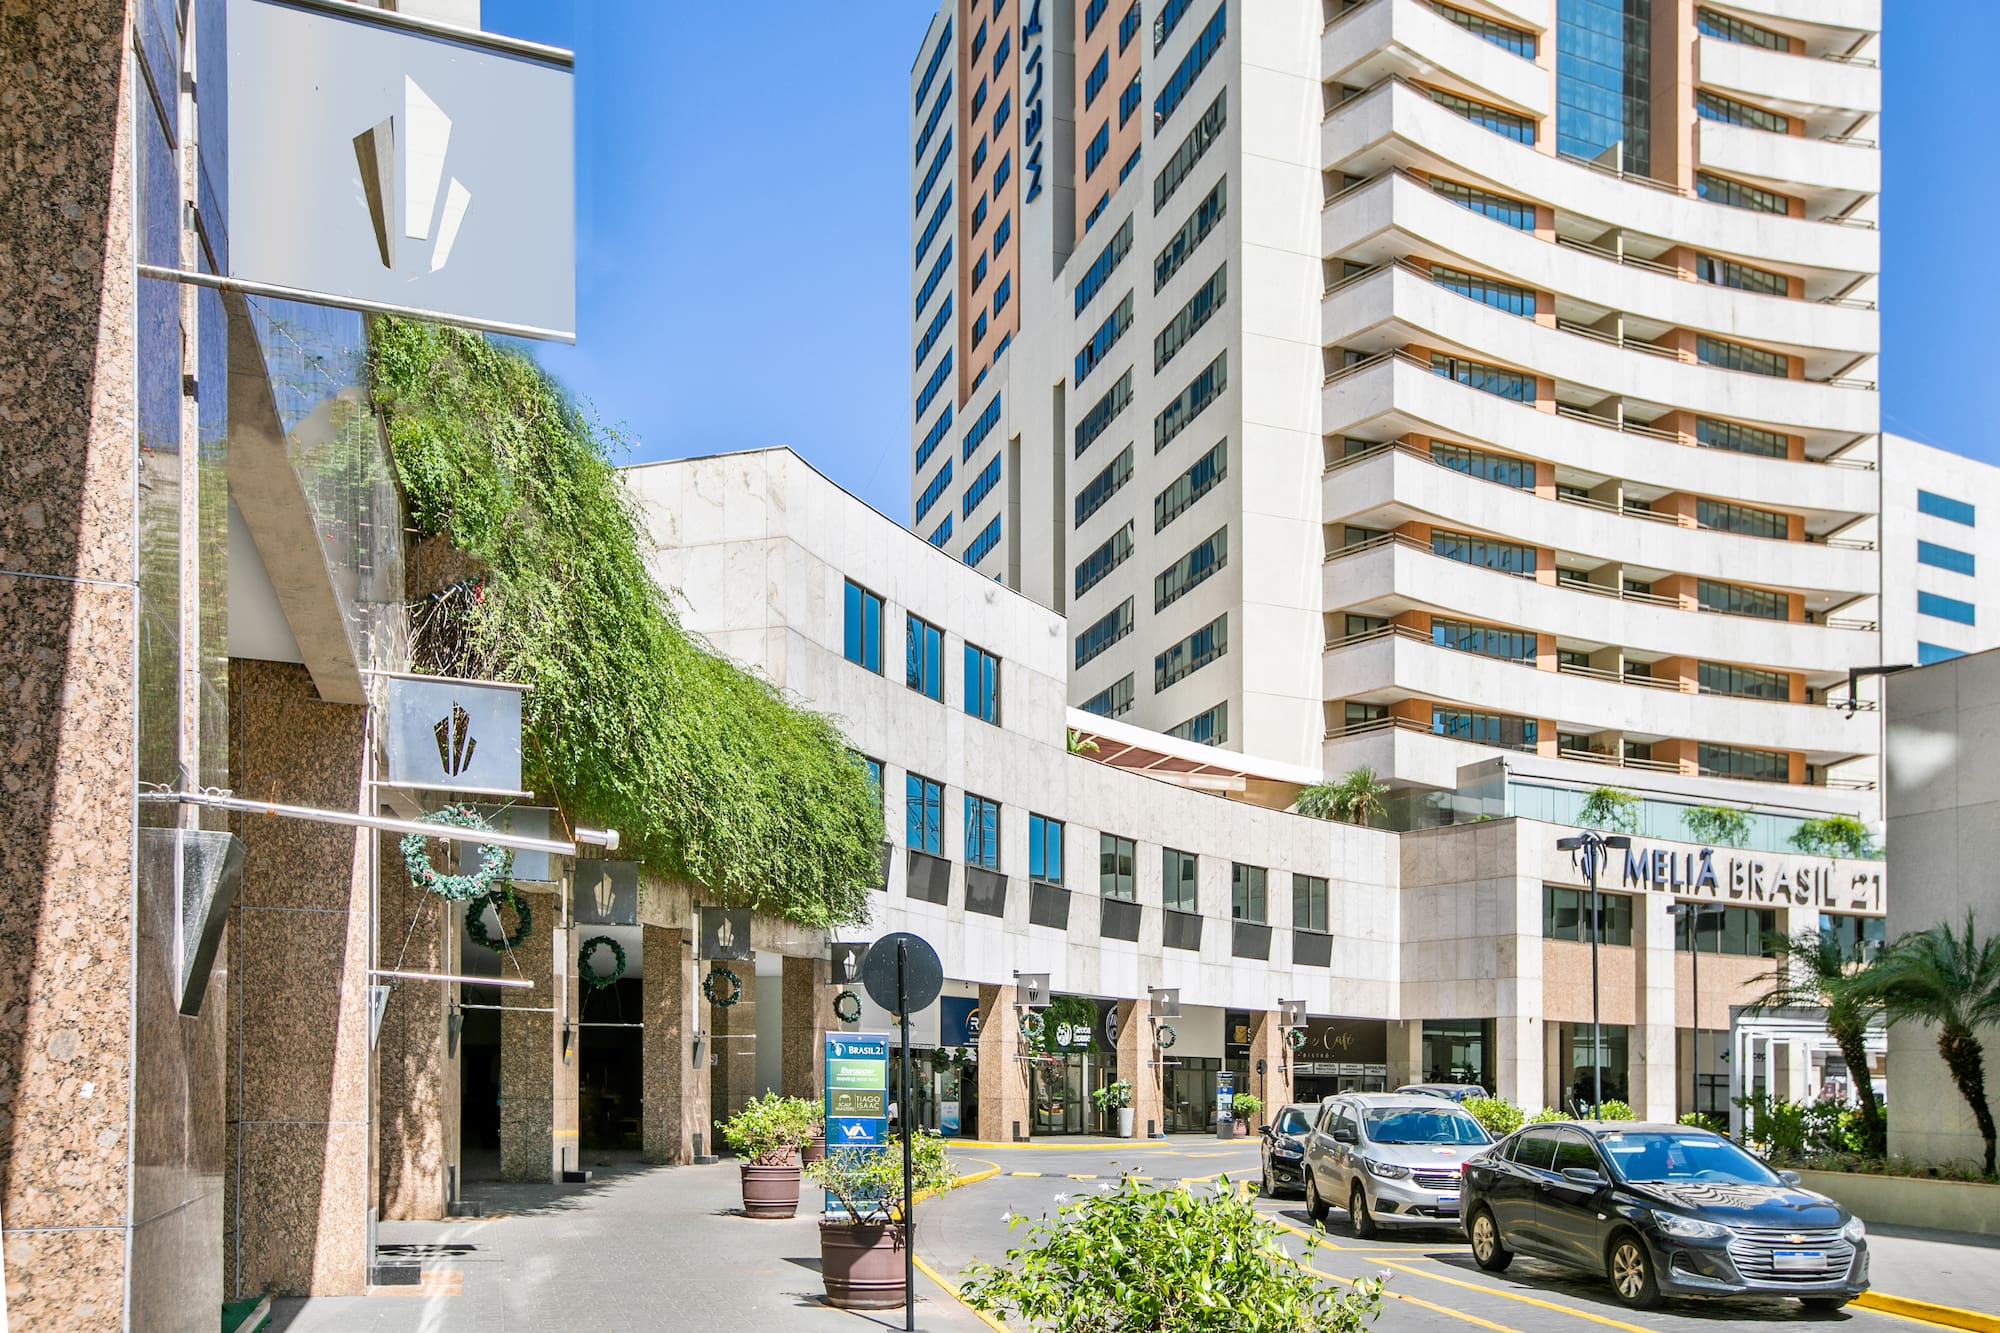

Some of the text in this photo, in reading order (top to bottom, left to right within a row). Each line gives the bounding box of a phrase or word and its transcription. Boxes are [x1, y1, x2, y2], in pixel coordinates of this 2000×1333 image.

[1729, 856, 1838, 906] BRASIL
[1851, 872, 1883, 910] 21
[856, 1095, 881, 1103] TIAGO
